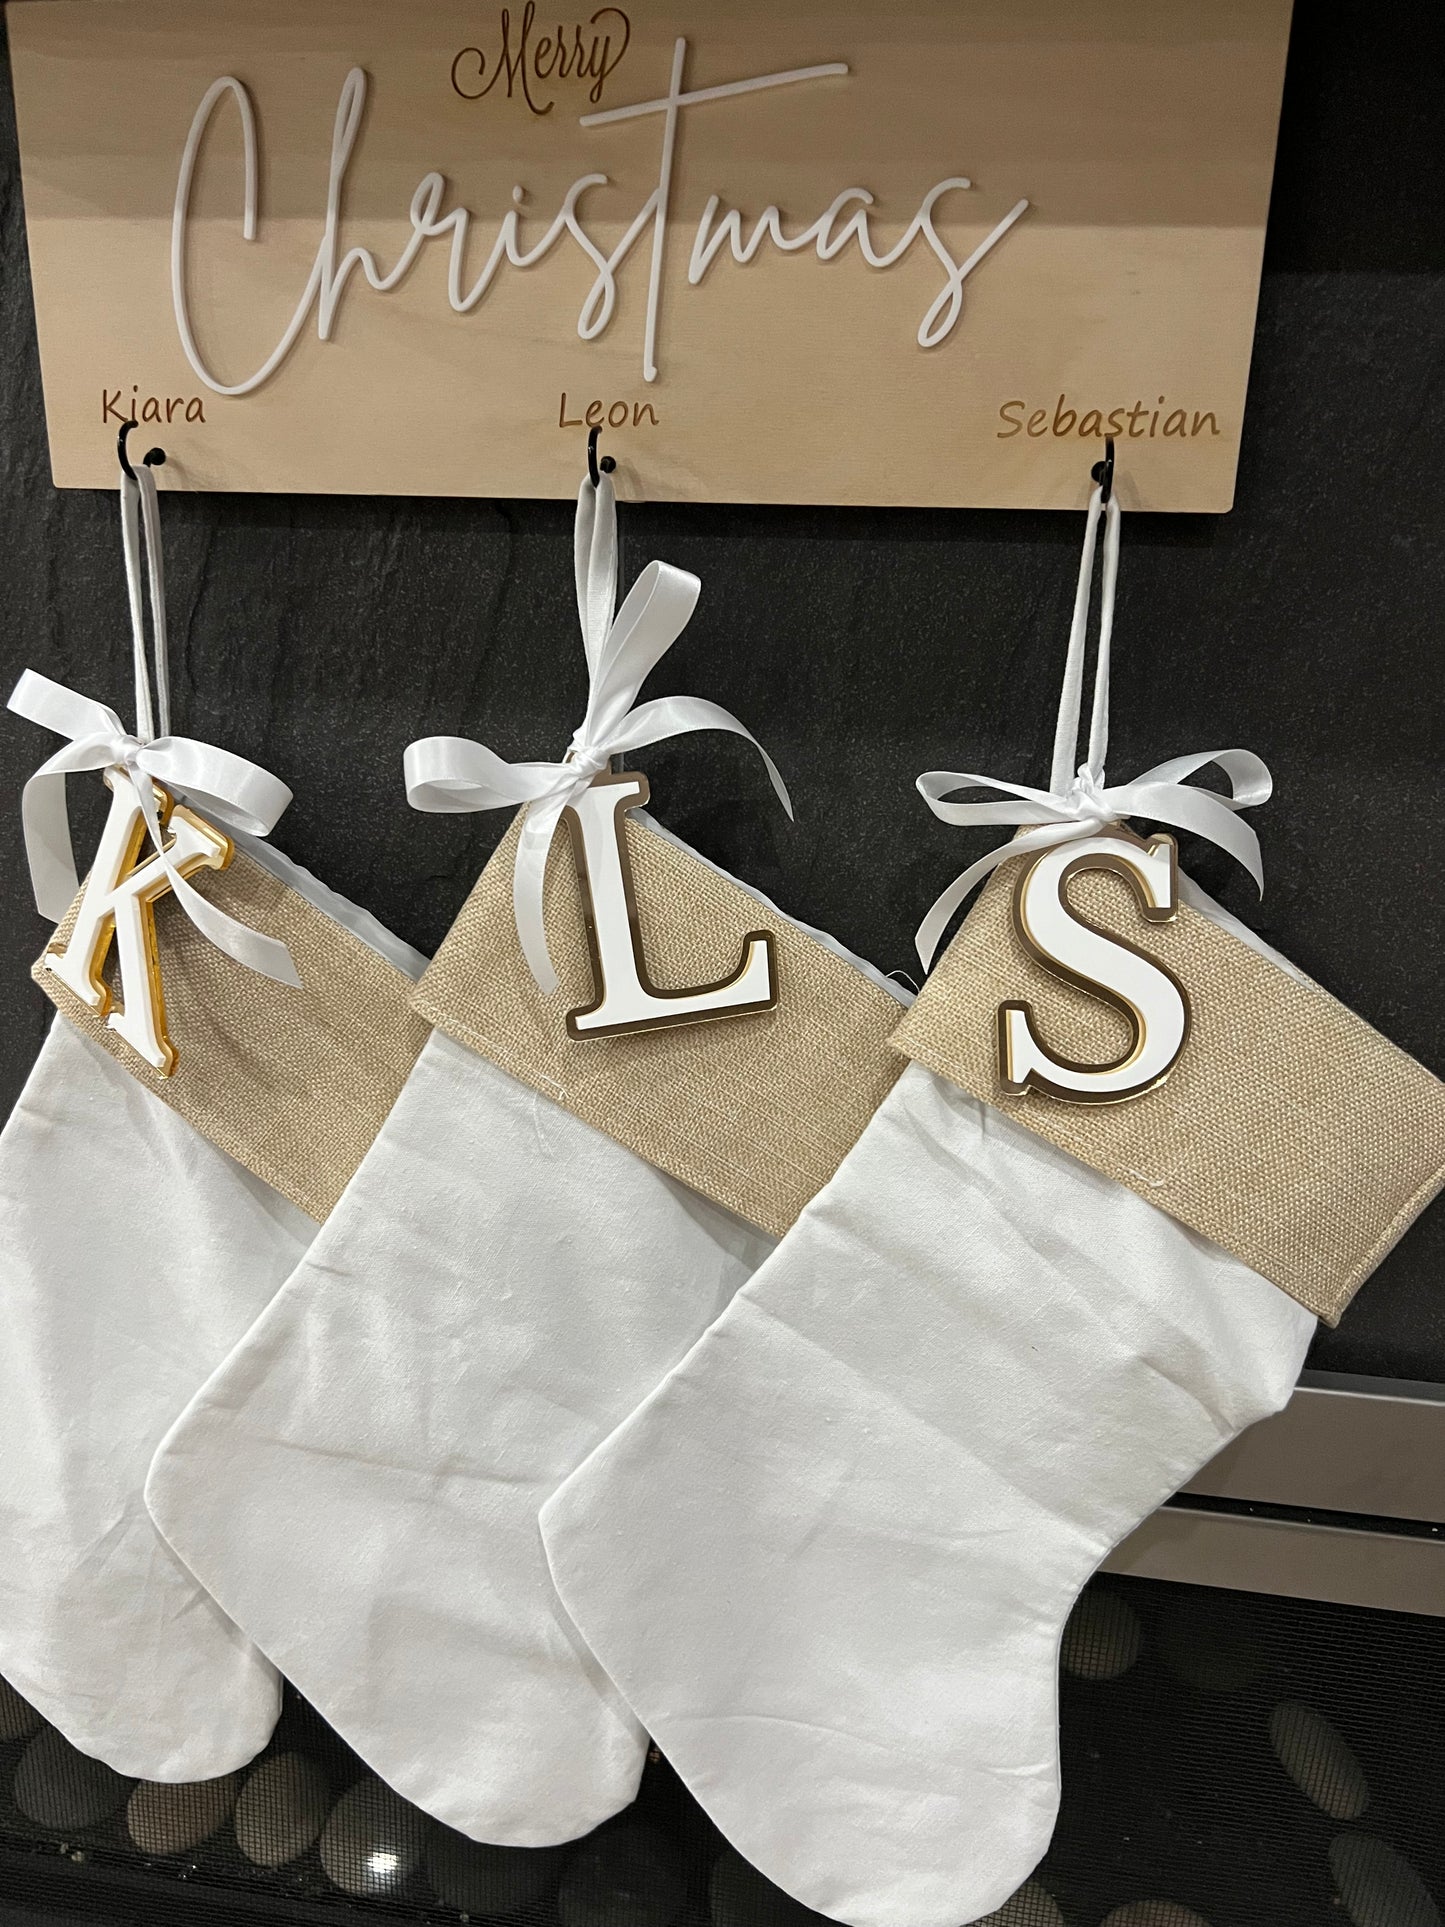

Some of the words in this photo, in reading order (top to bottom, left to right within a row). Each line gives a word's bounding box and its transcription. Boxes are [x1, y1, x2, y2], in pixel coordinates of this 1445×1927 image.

[452, 1, 630, 115] Merry
[171, 38, 1028, 395] Christmas
[102, 385, 206, 424] Kiara
[559, 392, 660, 428] Leon
[997, 394, 1221, 439] Sebastian
[45, 766, 234, 1079] K
[566, 772, 777, 1041] L
[998, 828, 1192, 1104] S
